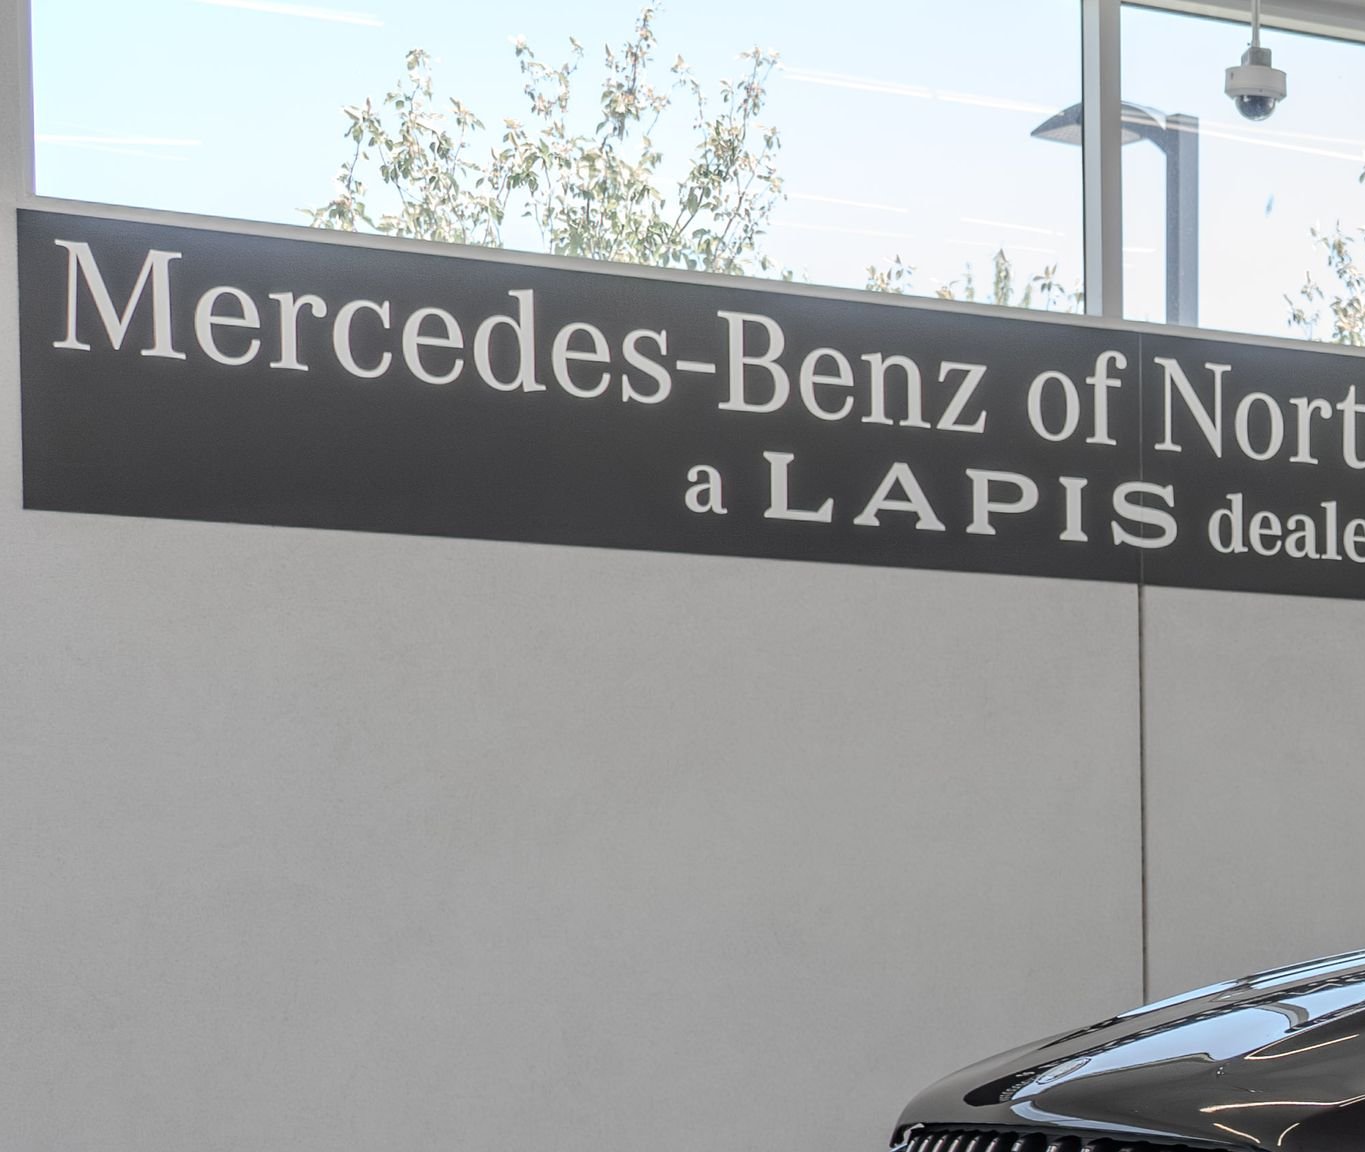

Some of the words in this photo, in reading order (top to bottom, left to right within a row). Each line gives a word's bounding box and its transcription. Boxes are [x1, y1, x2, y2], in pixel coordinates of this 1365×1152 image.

[52, 238, 987, 434] Mercedes-Benz
[1027, 350, 1128, 446] of
[685, 464, 728, 515] a
[763, 451, 1178, 549] LAPIS
